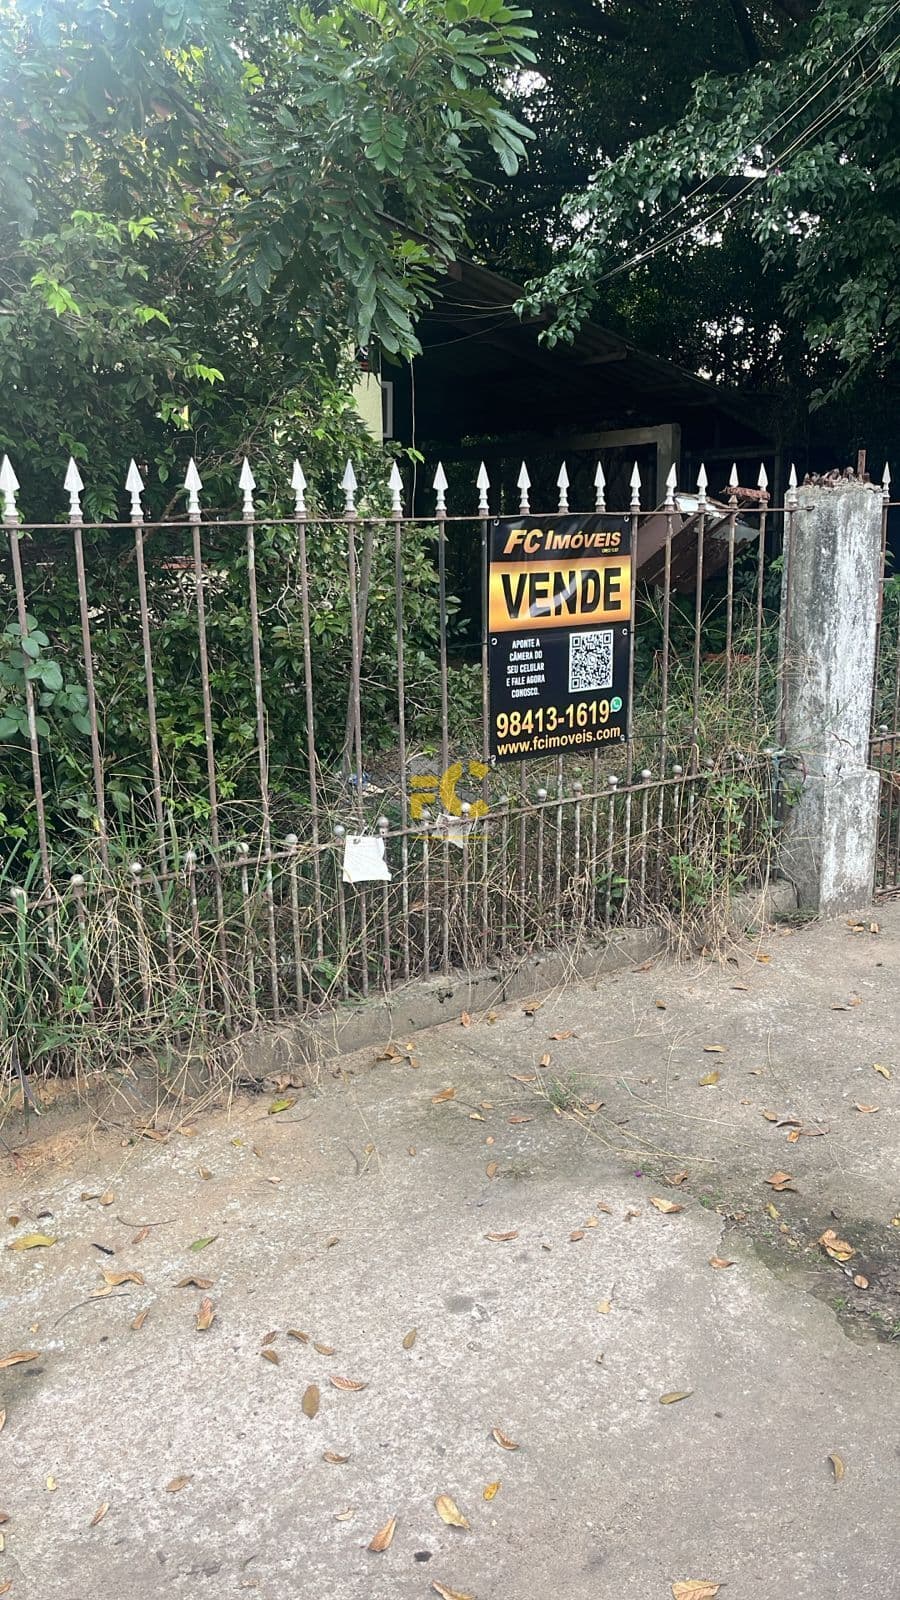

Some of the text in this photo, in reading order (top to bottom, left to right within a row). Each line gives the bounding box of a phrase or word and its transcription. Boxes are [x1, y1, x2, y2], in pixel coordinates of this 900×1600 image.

[503, 529, 621, 554] FC IMÓVEIS
[501, 567, 622, 619] VENDE
[512, 638, 541, 649] APONTE A
[510, 650, 543, 661] CÂMERA DO
[507, 662, 545, 674] SEU CELULAR
[506, 674, 546, 687] E FALE AGORA
[511, 687, 540, 698] CONOSCO.
[496, 699, 610, 738] 98413-1619
[497, 726, 621, 756] www.fcimoveis.com
